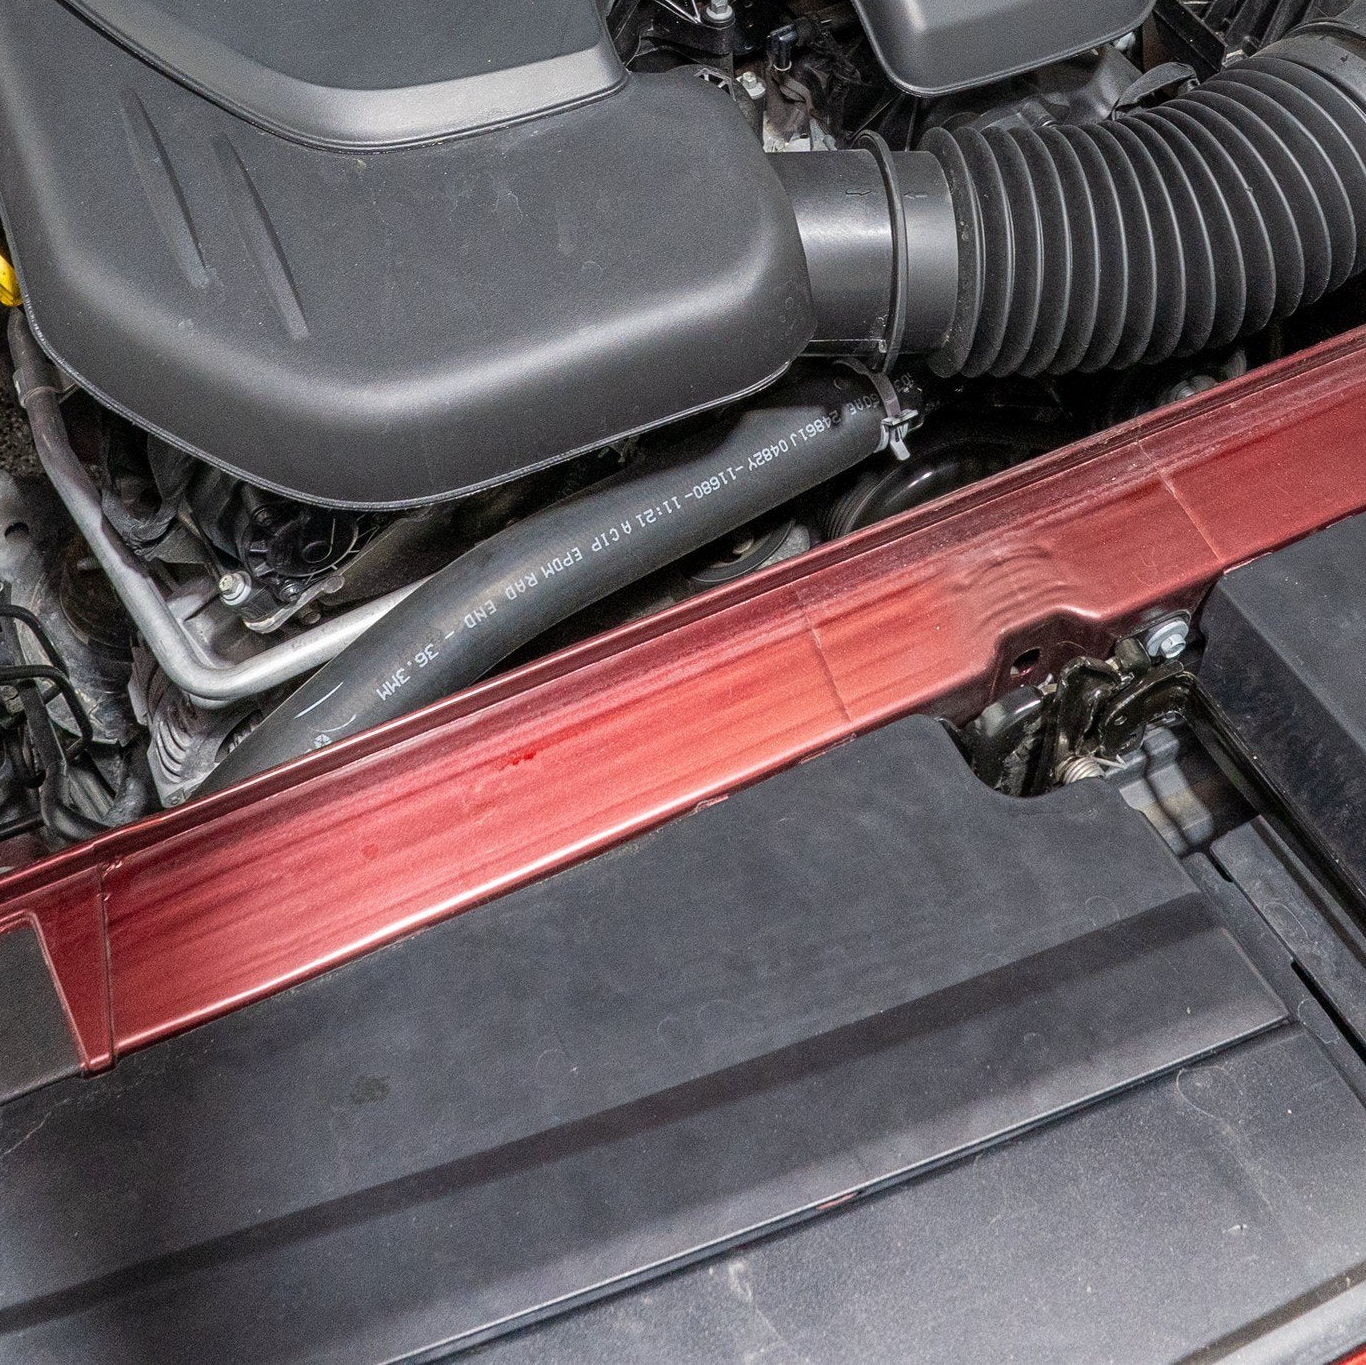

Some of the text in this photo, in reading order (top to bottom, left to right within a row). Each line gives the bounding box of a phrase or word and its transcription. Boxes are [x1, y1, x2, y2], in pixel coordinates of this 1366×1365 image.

[635, 495, 682, 528] 11:21
[540, 546, 584, 579] EPDM
[501, 571, 540, 601] RAD
[463, 599, 499, 629] END
[375, 642, 441, 701] 36.3MM
